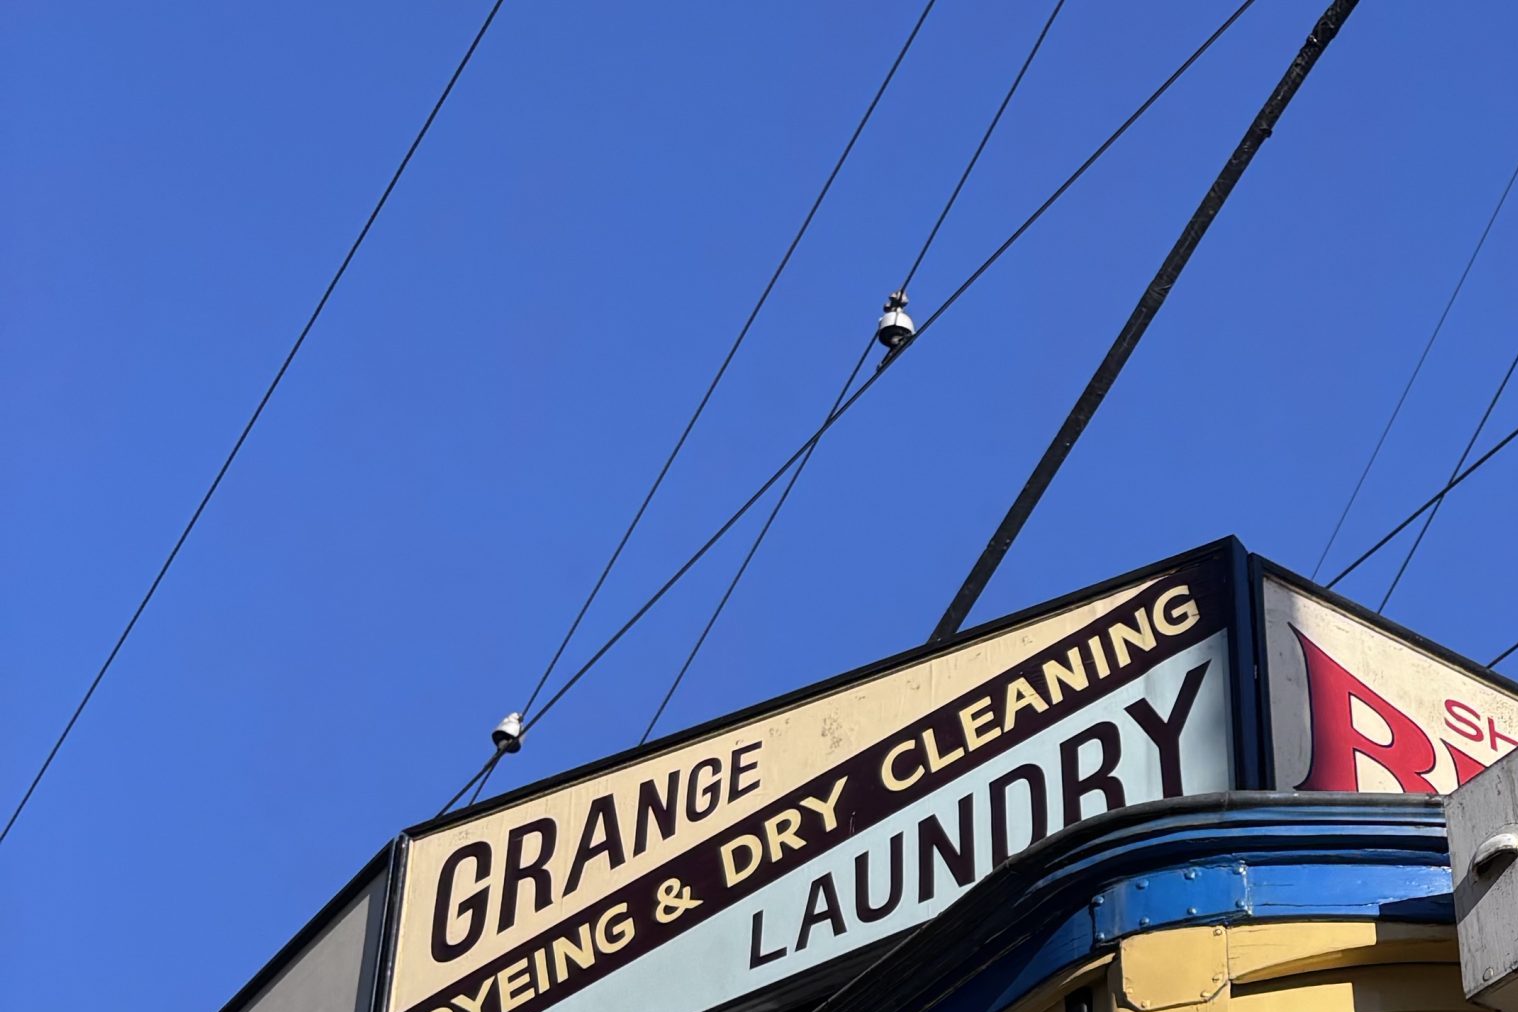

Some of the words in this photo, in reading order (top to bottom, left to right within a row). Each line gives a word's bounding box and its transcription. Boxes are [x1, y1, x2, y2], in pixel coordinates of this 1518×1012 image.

[429, 739, 764, 964] GRANGE
[655, 876, 704, 922] &
[719, 778, 848, 890] DRY
[880, 585, 1200, 792] CLEANING
[748, 657, 1213, 970] LAUNDRY
